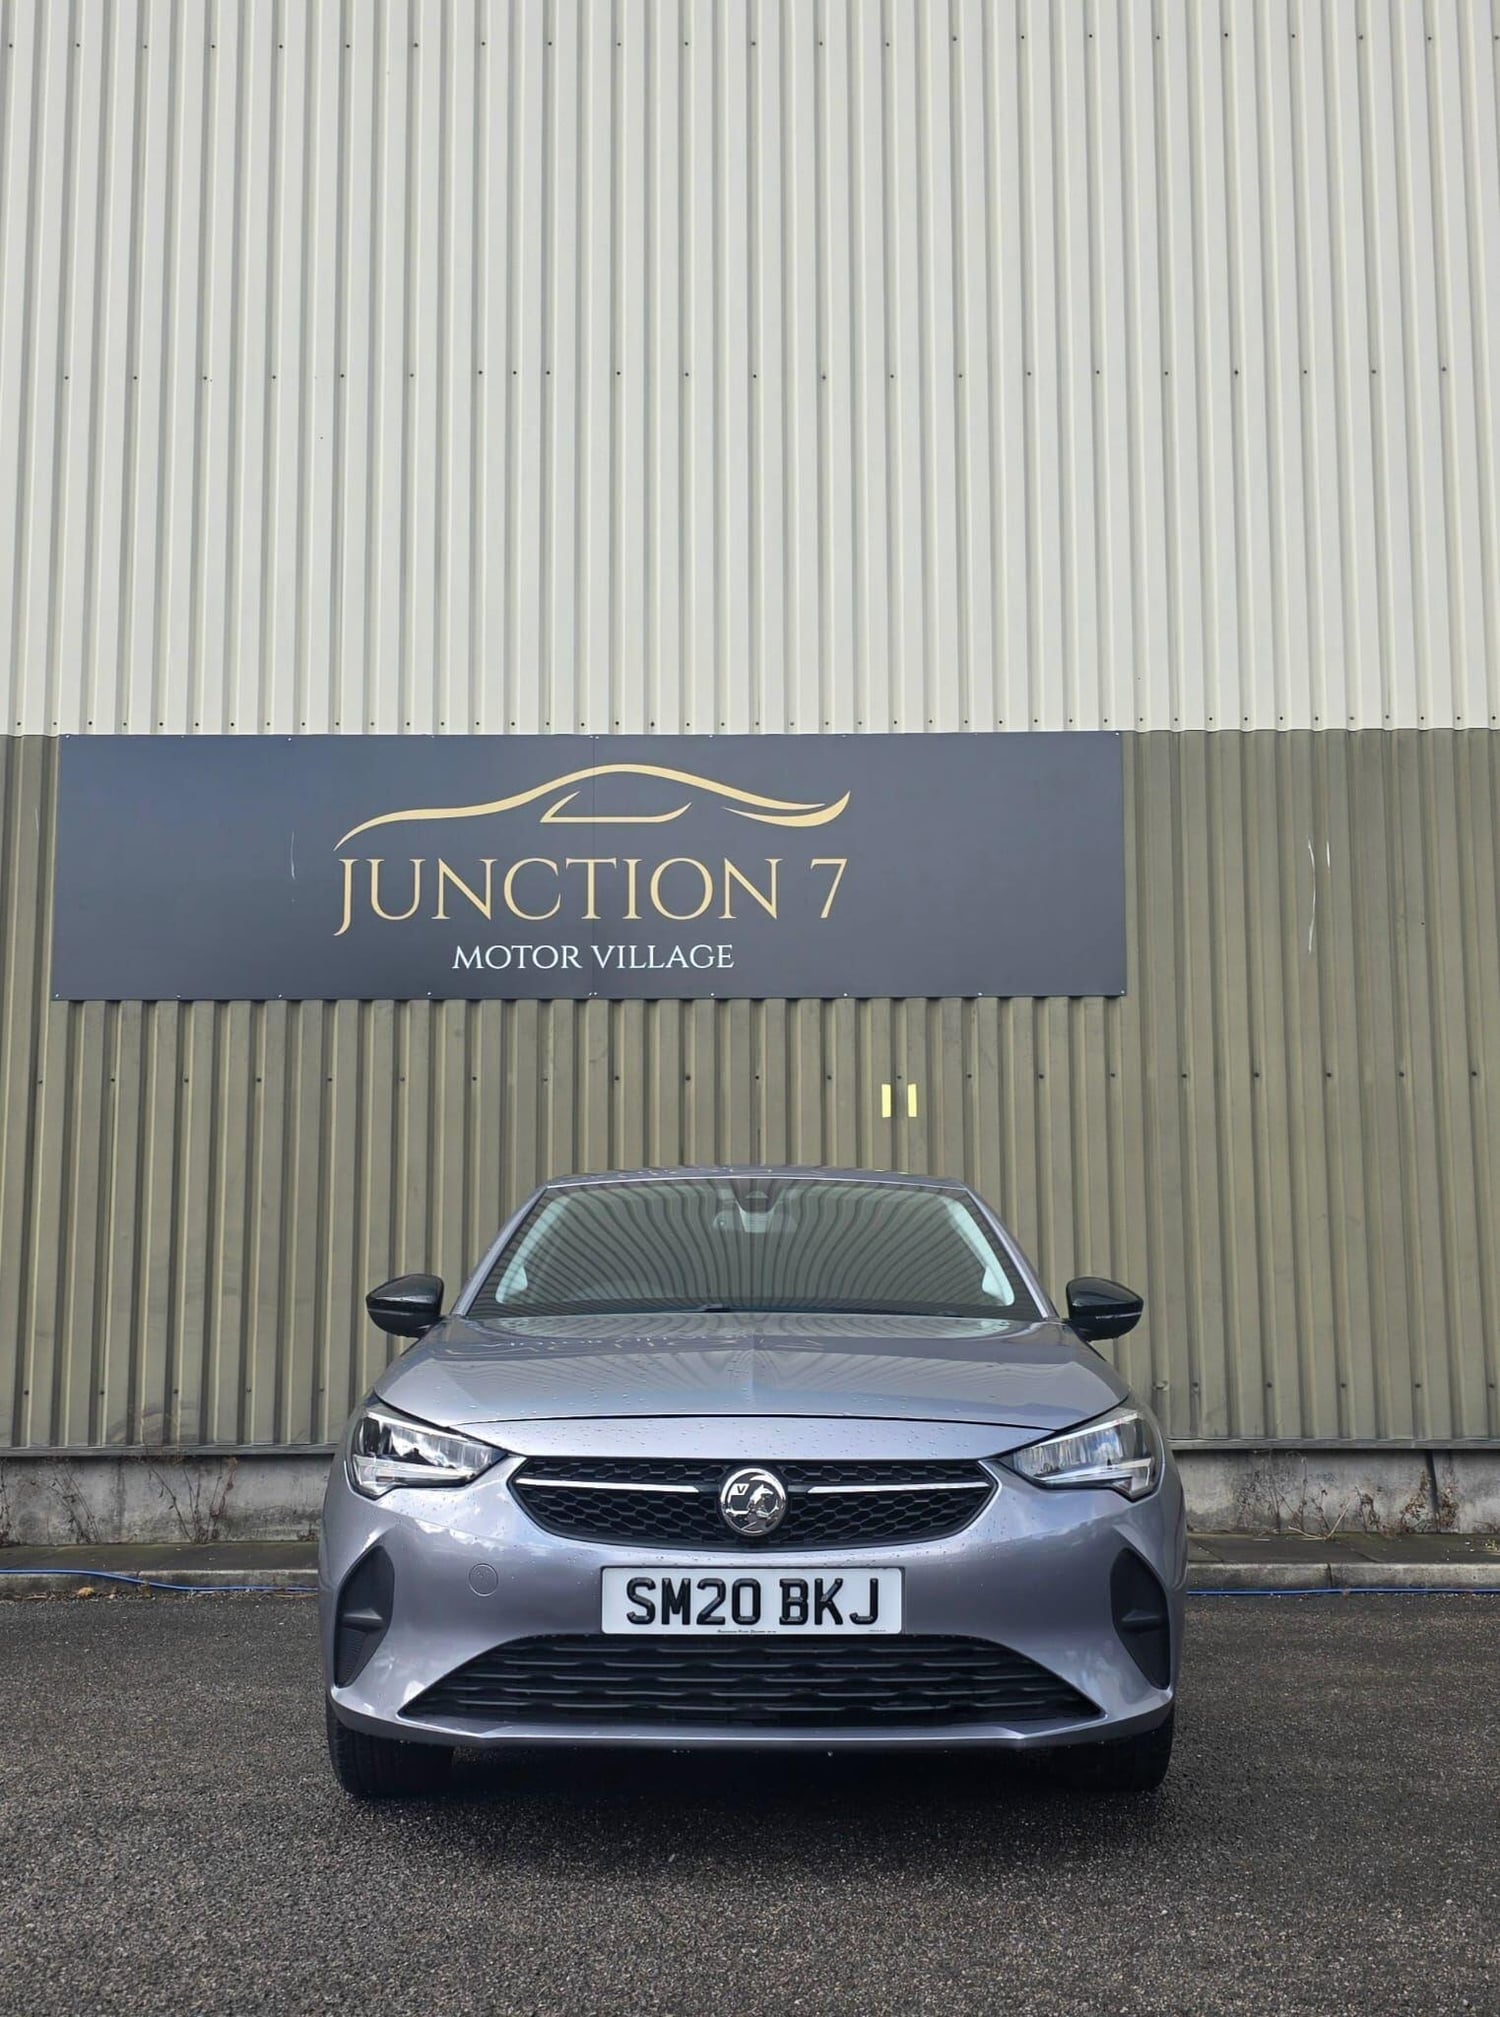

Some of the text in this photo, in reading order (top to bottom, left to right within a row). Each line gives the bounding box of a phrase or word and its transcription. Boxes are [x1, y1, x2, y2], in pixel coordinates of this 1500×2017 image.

[333, 857, 848, 936] JUNCTION 7
[452, 944, 735, 970] MOTOR VILLAGE
[626, 1577, 879, 1625] SM20 BKJ
